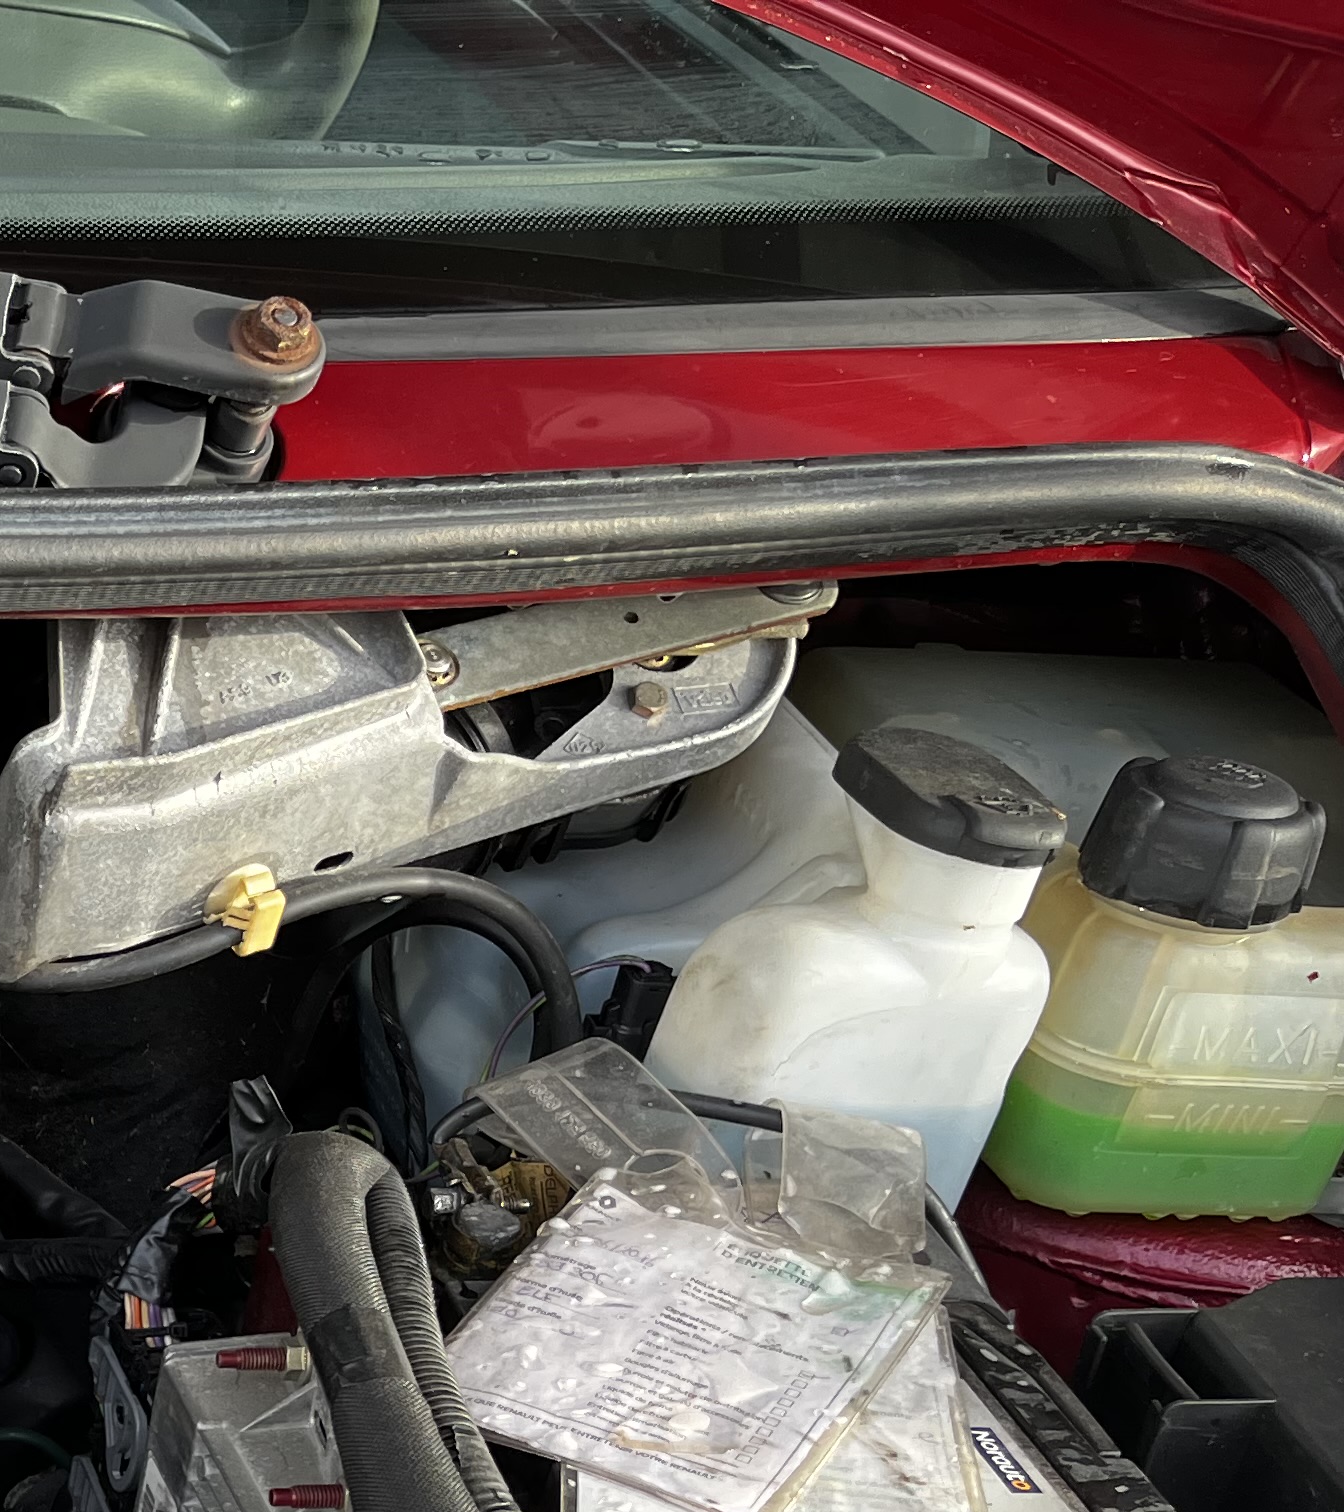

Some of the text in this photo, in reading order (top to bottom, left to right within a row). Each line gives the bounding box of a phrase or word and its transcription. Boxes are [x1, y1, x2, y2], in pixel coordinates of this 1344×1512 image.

[1192, 1023, 1319, 1065] MAXI
[1173, 1103, 1281, 1135] MINI
[498, 1402, 541, 1424] RENAULT
[974, 1429, 1032, 1491] Norauto
